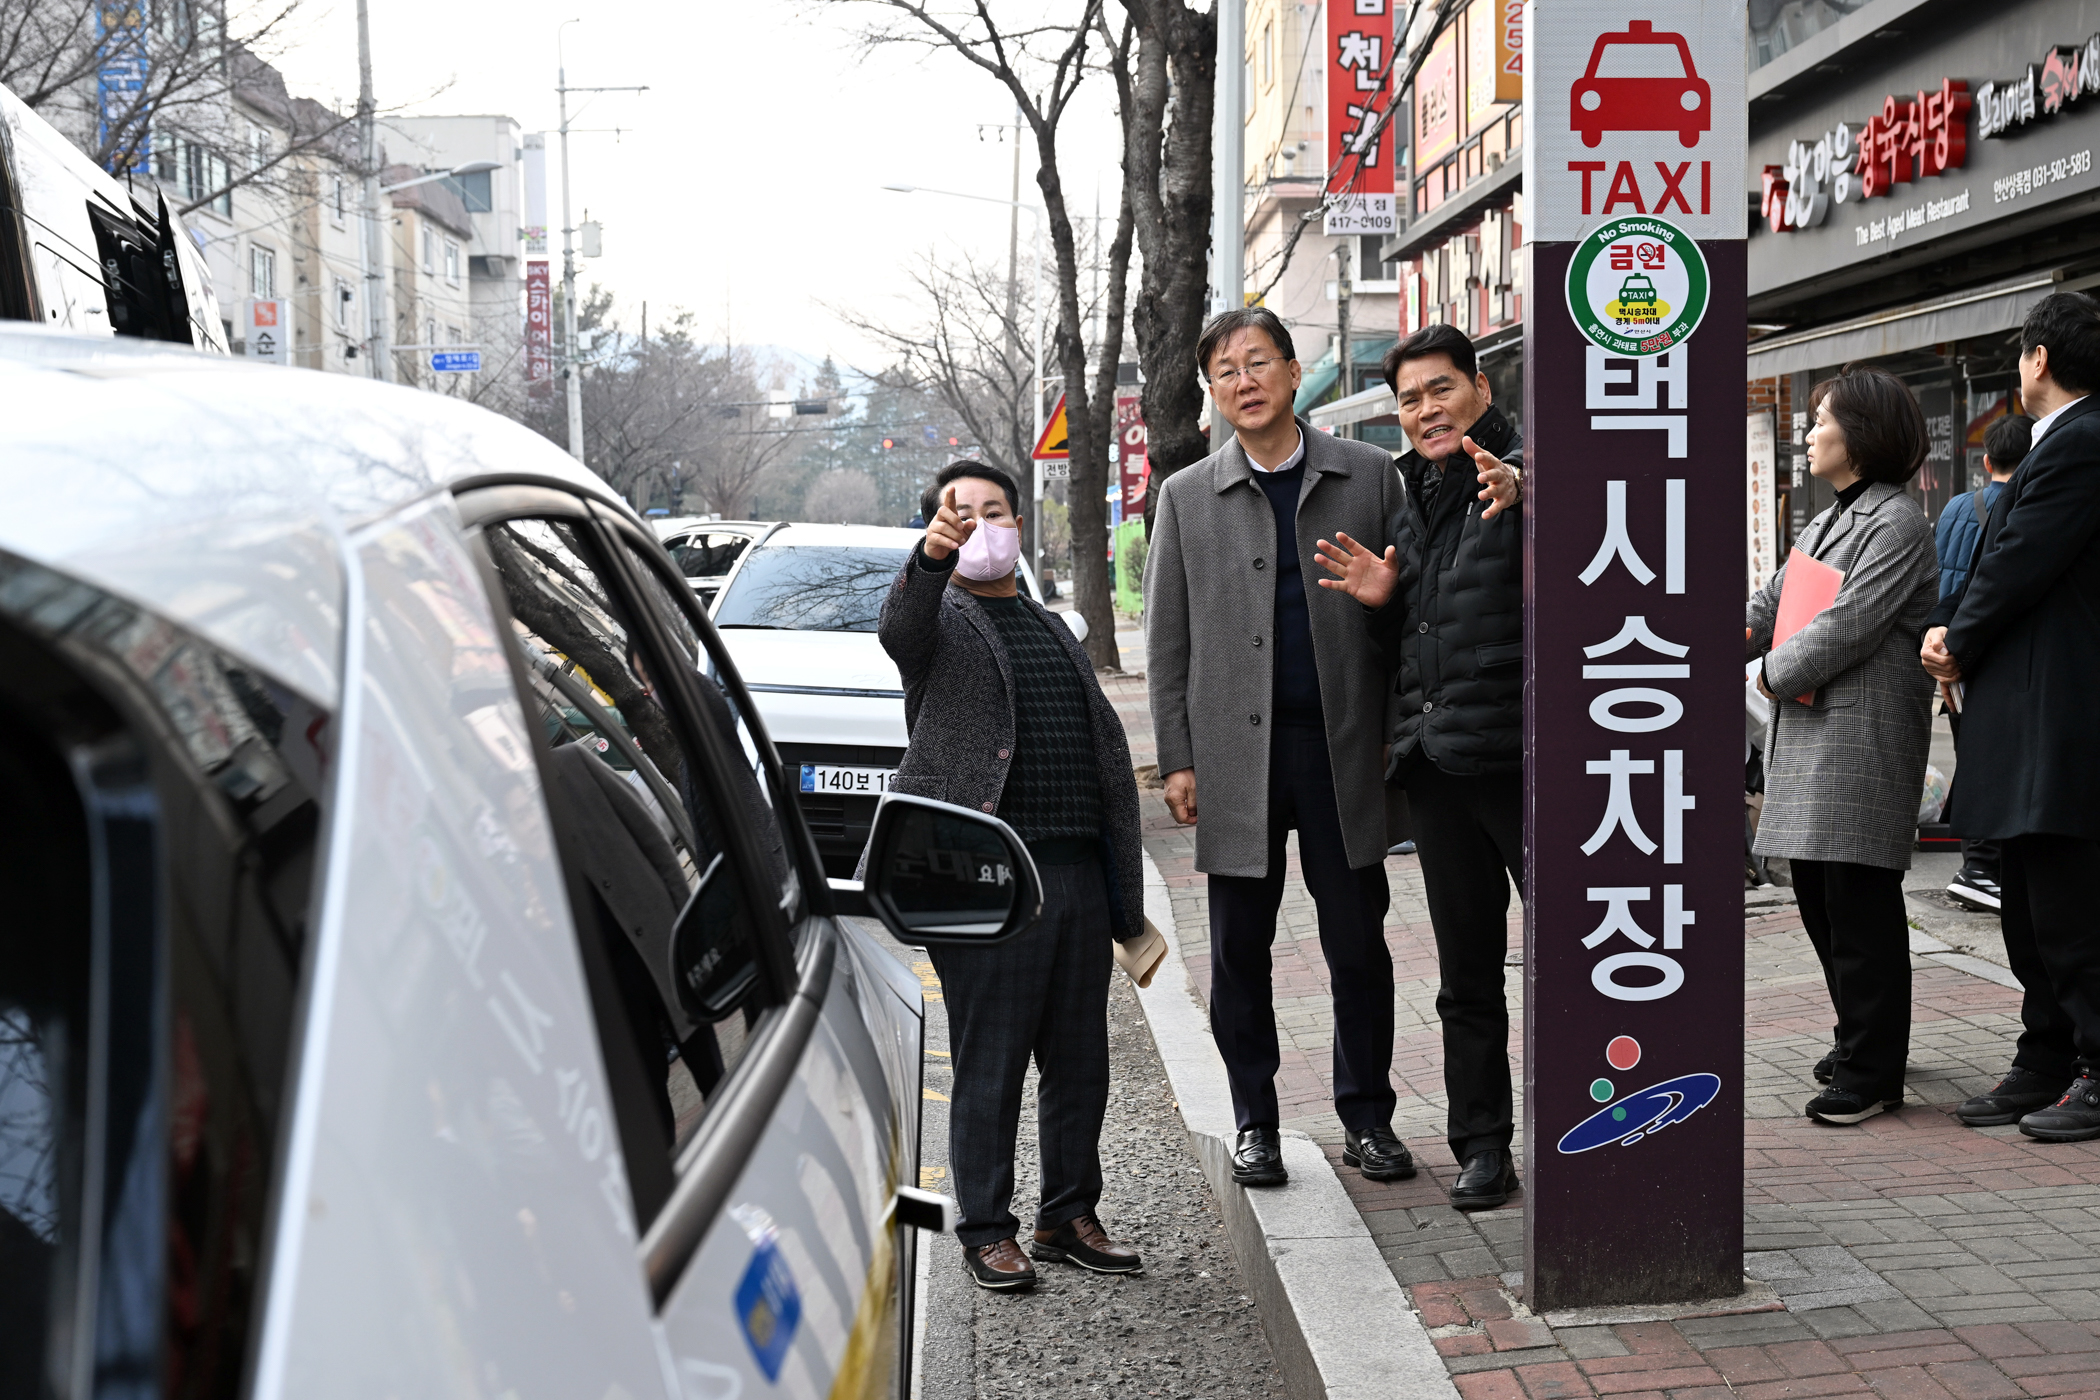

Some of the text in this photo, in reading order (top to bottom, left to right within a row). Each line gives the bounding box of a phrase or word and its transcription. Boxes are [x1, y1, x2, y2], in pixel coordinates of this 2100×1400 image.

[1994, 150, 2092, 203] 안산상록점 031-502-5813
[1568, 161, 1711, 215] TAXI
[1329, 215, 1392, 229] 417-0109
[1855, 188, 1970, 246] The Best Aged Meat Restaurant
[1597, 222, 1675, 243] No Smoking
[1610, 243, 1665, 270] 금연
[1628, 291, 1647, 300] TAXI
[1615, 317, 1661, 326] 경계 5m이내
[1618, 308, 1657, 316] 택시승차대
[1588, 322, 1690, 352] 흡연시 과태료 5만원 부과
[818, 770, 869, 791] 140보
